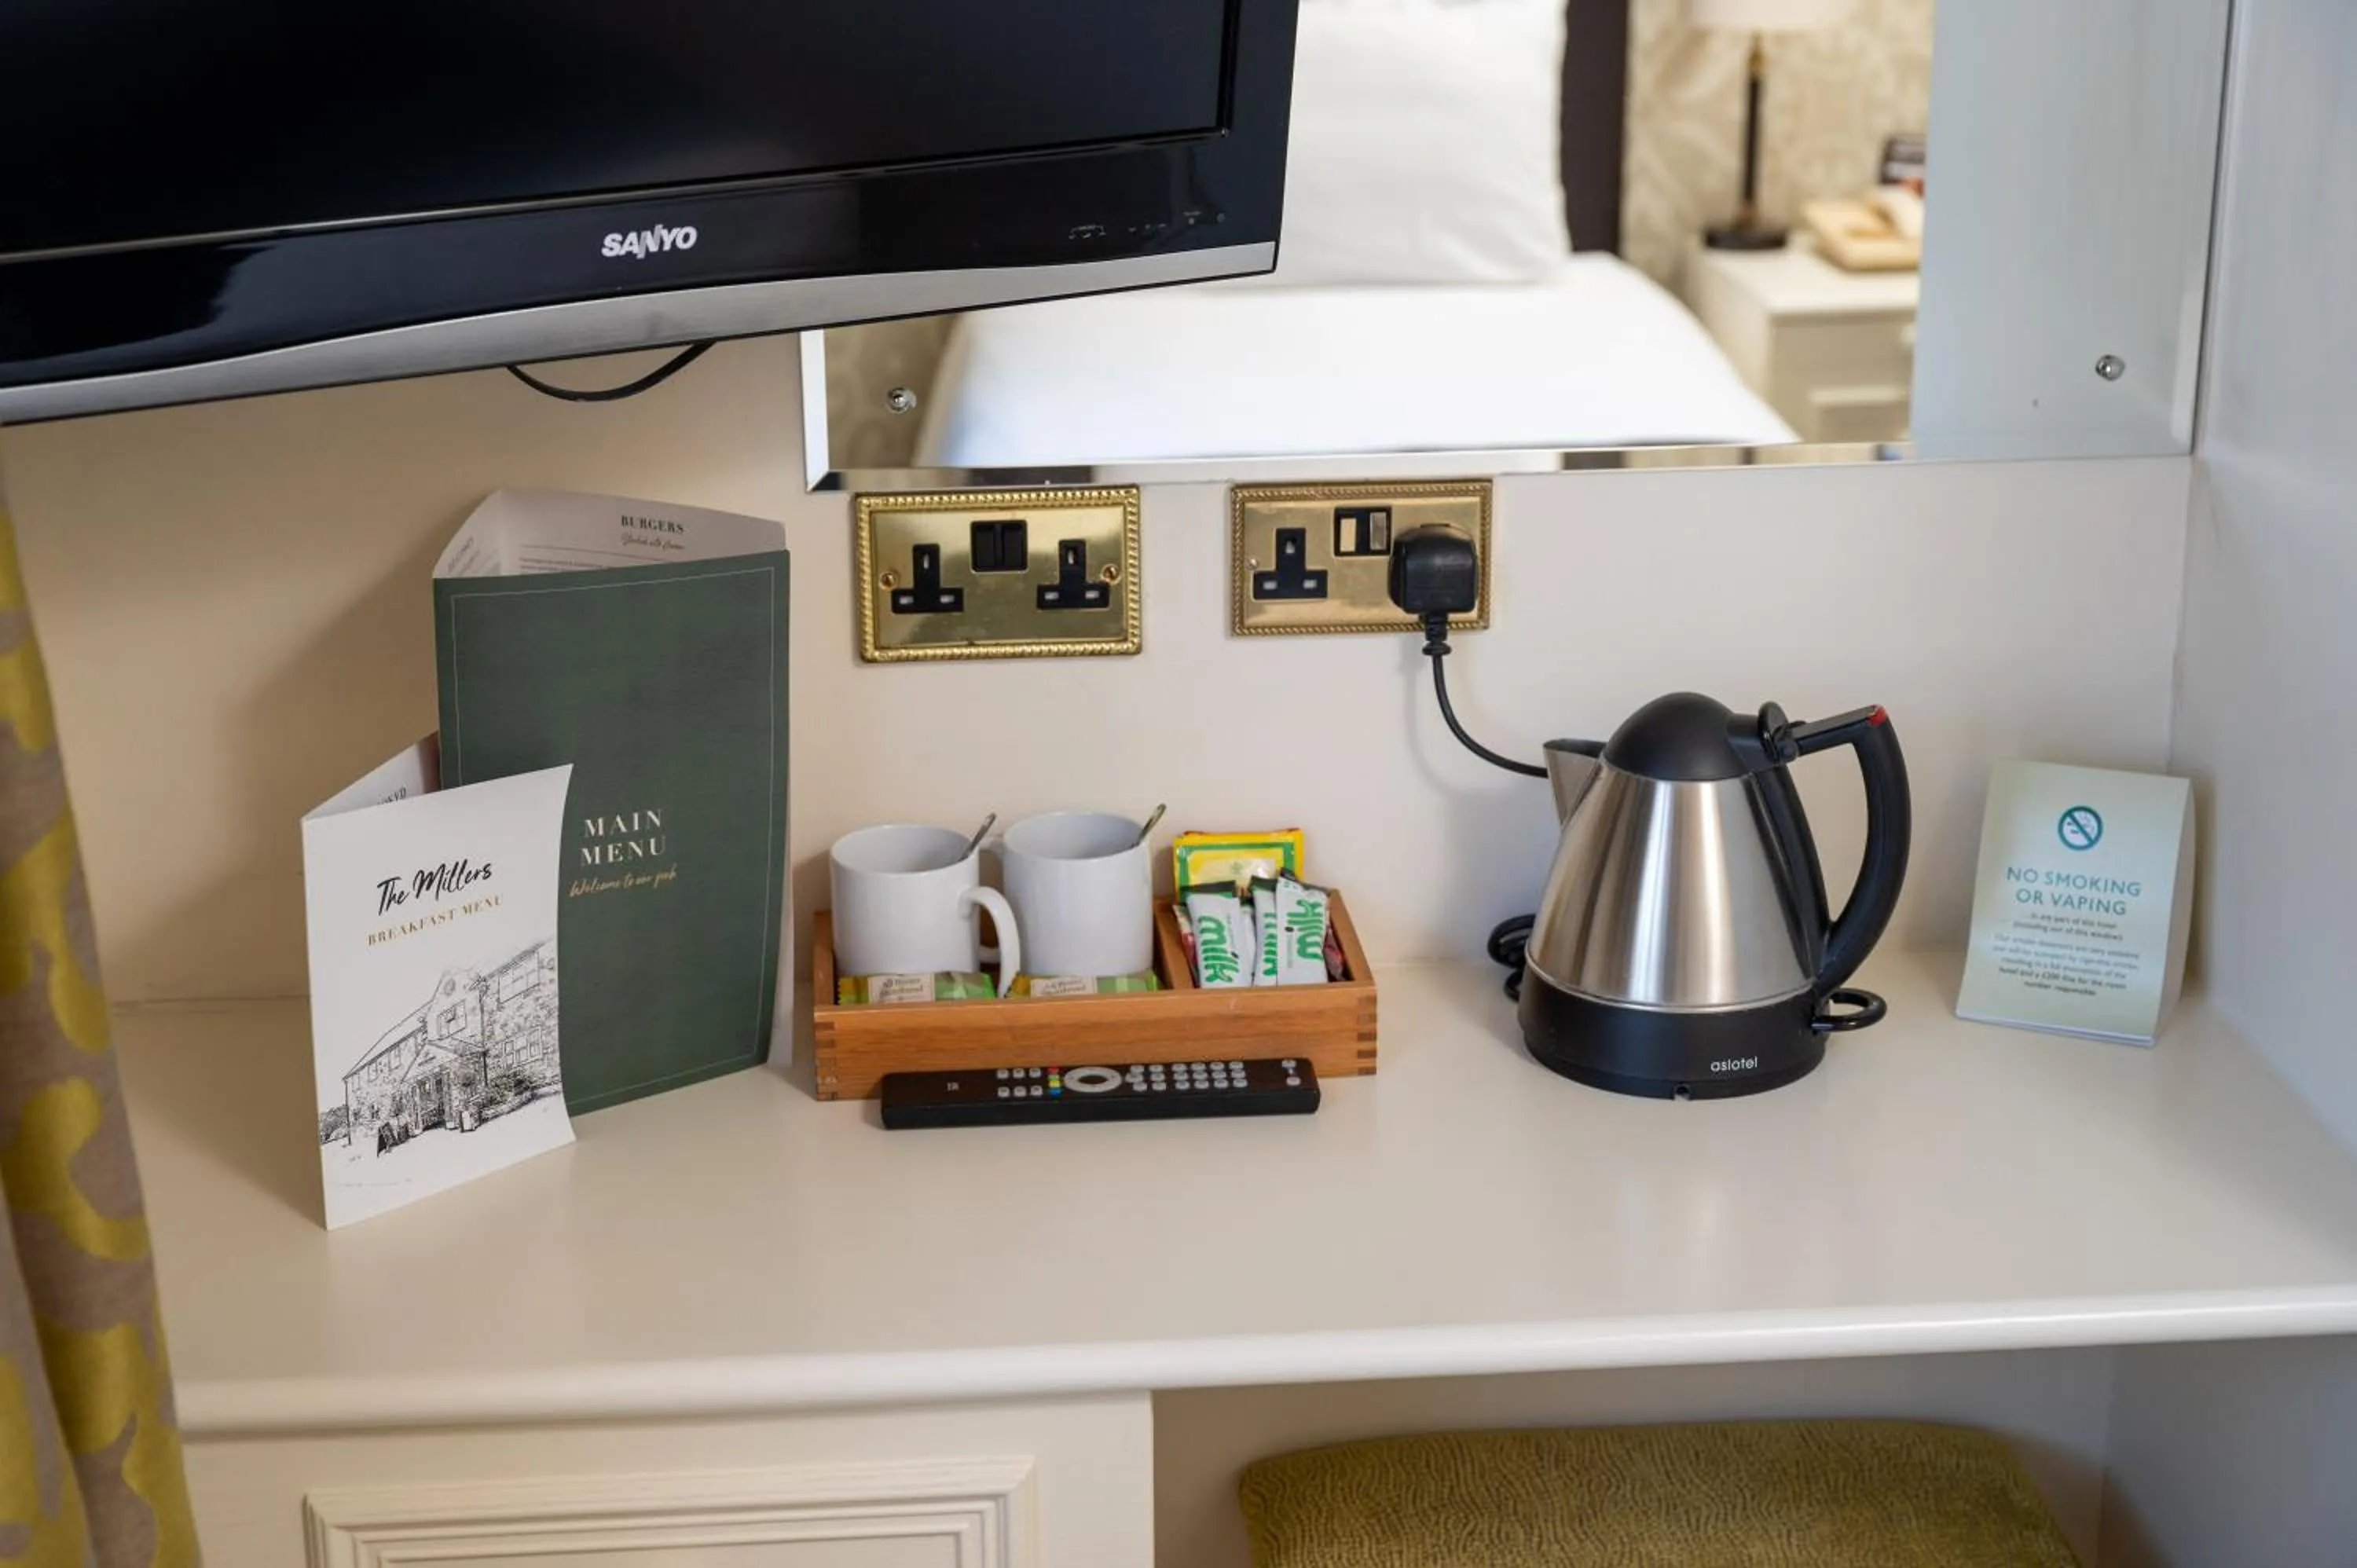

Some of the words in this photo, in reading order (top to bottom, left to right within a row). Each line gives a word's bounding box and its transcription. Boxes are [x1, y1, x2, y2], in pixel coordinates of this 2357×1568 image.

[601, 224, 698, 259] SANYO
[621, 515, 684, 535] BURGERS
[585, 808, 665, 838] MAIN
[581, 835, 666, 866] MENU
[376, 876, 409, 916] The
[412, 859, 493, 901] Millers
[2007, 866, 2039, 884] NO
[2043, 870, 2143, 898] SMOKING
[2015, 888, 2044, 906] OR
[2050, 891, 2128, 916] VAPING
[367, 909, 457, 947] BREAKFAST
[461, 896, 504, 916] MENU
[1285, 899, 1324, 962] milk
[1197, 914, 1240, 984] milk
[1710, 1056, 1758, 1072] aslotel
